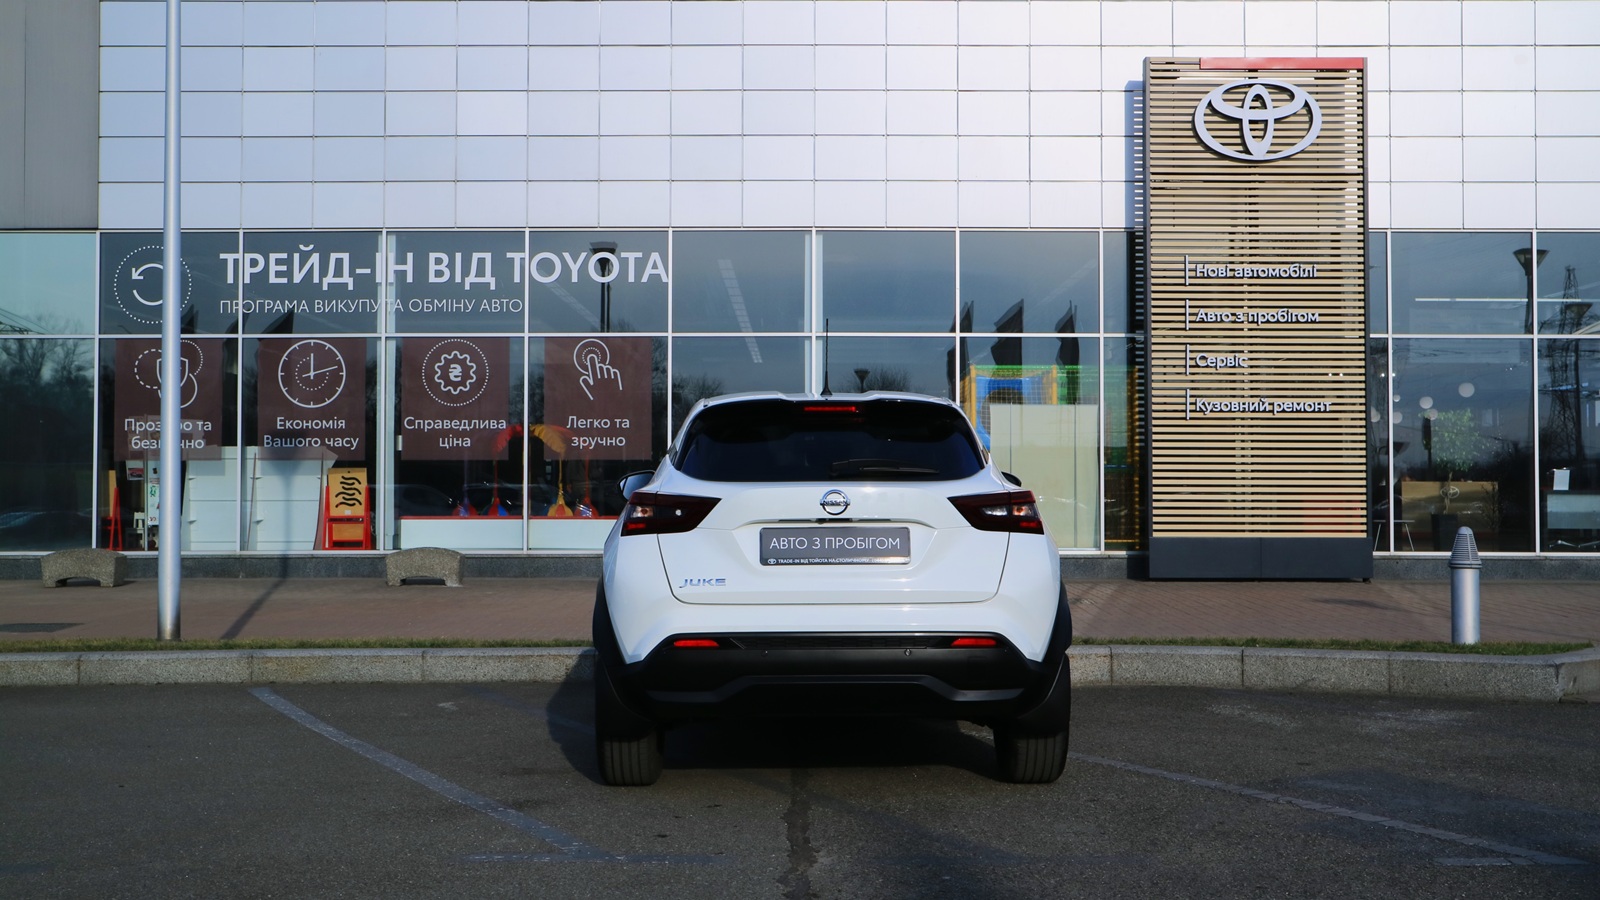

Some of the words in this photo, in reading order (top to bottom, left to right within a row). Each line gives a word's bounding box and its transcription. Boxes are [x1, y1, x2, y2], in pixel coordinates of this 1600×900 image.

[219, 244, 413, 291] ТРЕЙД-ІН
[428, 252, 496, 290] ВІД
[506, 252, 668, 284] TOYOTA
[1195, 264, 1231, 278] Нові
[1234, 263, 1317, 278] автомобілі
[220, 299, 310, 314] ПРОГРАМА
[315, 299, 381, 313] ВИКУПУ
[385, 298, 404, 312] ТА
[409, 298, 475, 313] ОБМІНУ
[479, 298, 523, 313] АВТО
[1195, 309, 1232, 322] Авто
[1235, 311, 1244, 322] з
[1248, 308, 1319, 326] пробігом
[1195, 353, 1249, 371] Сервіс
[1195, 397, 1269, 416] Кузовний
[1272, 400, 1332, 416] ремонт
[196, 421, 212, 431] та
[276, 416, 346, 431] Економія
[403, 417, 507, 432] Справедлива
[567, 416, 610, 429] Легко
[614, 418, 630, 429] та
[263, 435, 321, 448] Вашого
[325, 437, 359, 450] часу
[439, 434, 471, 449] ціна
[571, 436, 626, 450] зручно
[769, 537, 808, 550] АВТО
[825, 537, 900, 550] ПРОБІГОМ
[678, 578, 727, 589] JUKE
